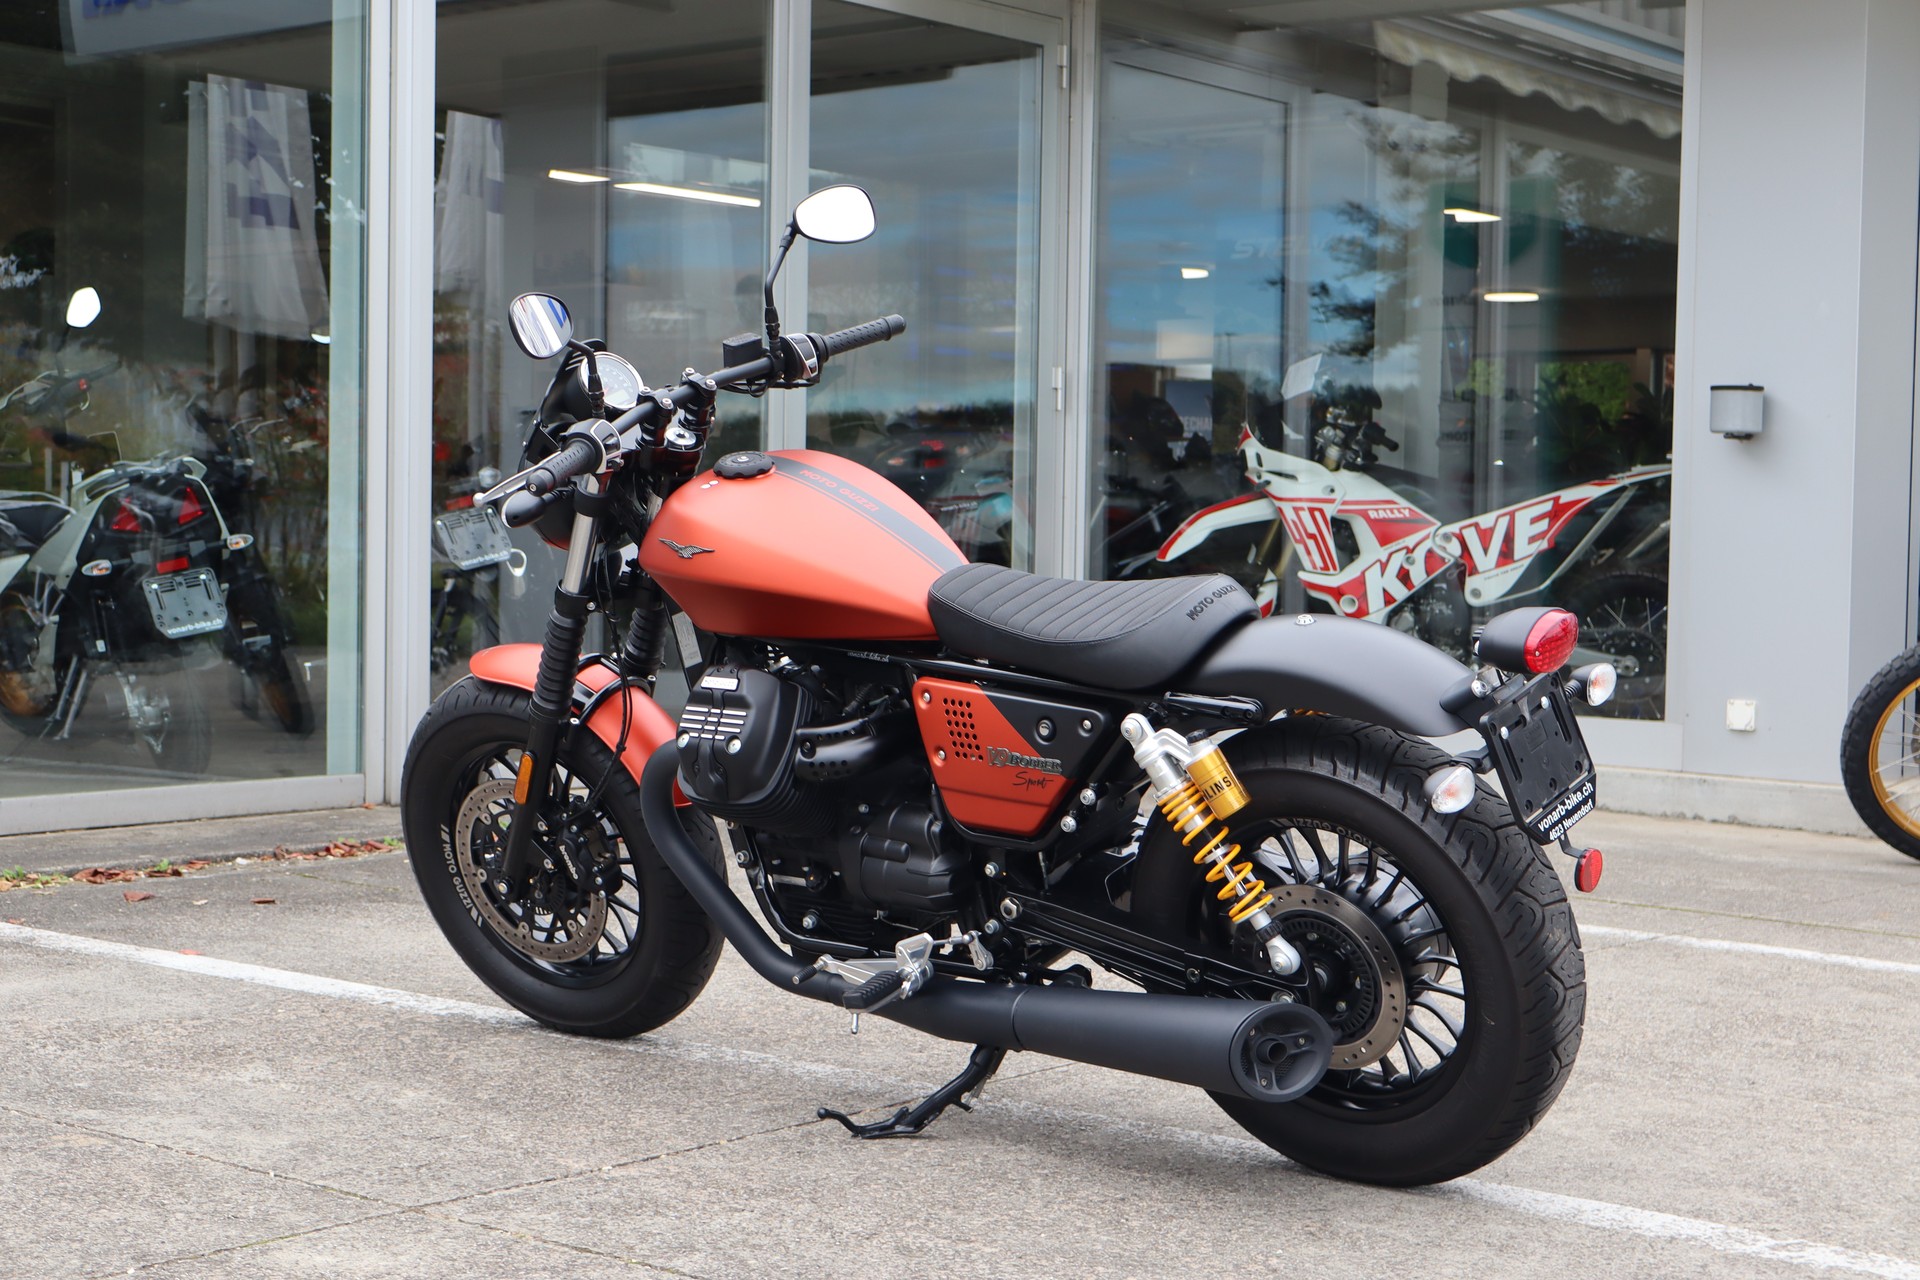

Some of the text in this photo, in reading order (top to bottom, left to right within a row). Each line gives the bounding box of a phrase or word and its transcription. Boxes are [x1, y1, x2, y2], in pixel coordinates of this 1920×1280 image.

[800, 469, 879, 512] MOTO GUZZI
[1367, 508, 1410, 519] RALLY
[1186, 584, 1238, 621] MOTO GUZZI
[167, 618, 223, 634] vonarb-bike.ch
[1009, 752, 1061, 773] BOBBER
[1012, 771, 1054, 791] Sport
[1203, 776, 1232, 799] LINS
[1538, 781, 1594, 832] vonarb-bike.ch
[1549, 798, 1594, 841] 4623 Neuendorf
[1294, 818, 1372, 848] MOTO GUZZI
[442, 843, 473, 909] MOTO GUZZI
[559, 844, 579, 880] brembo
